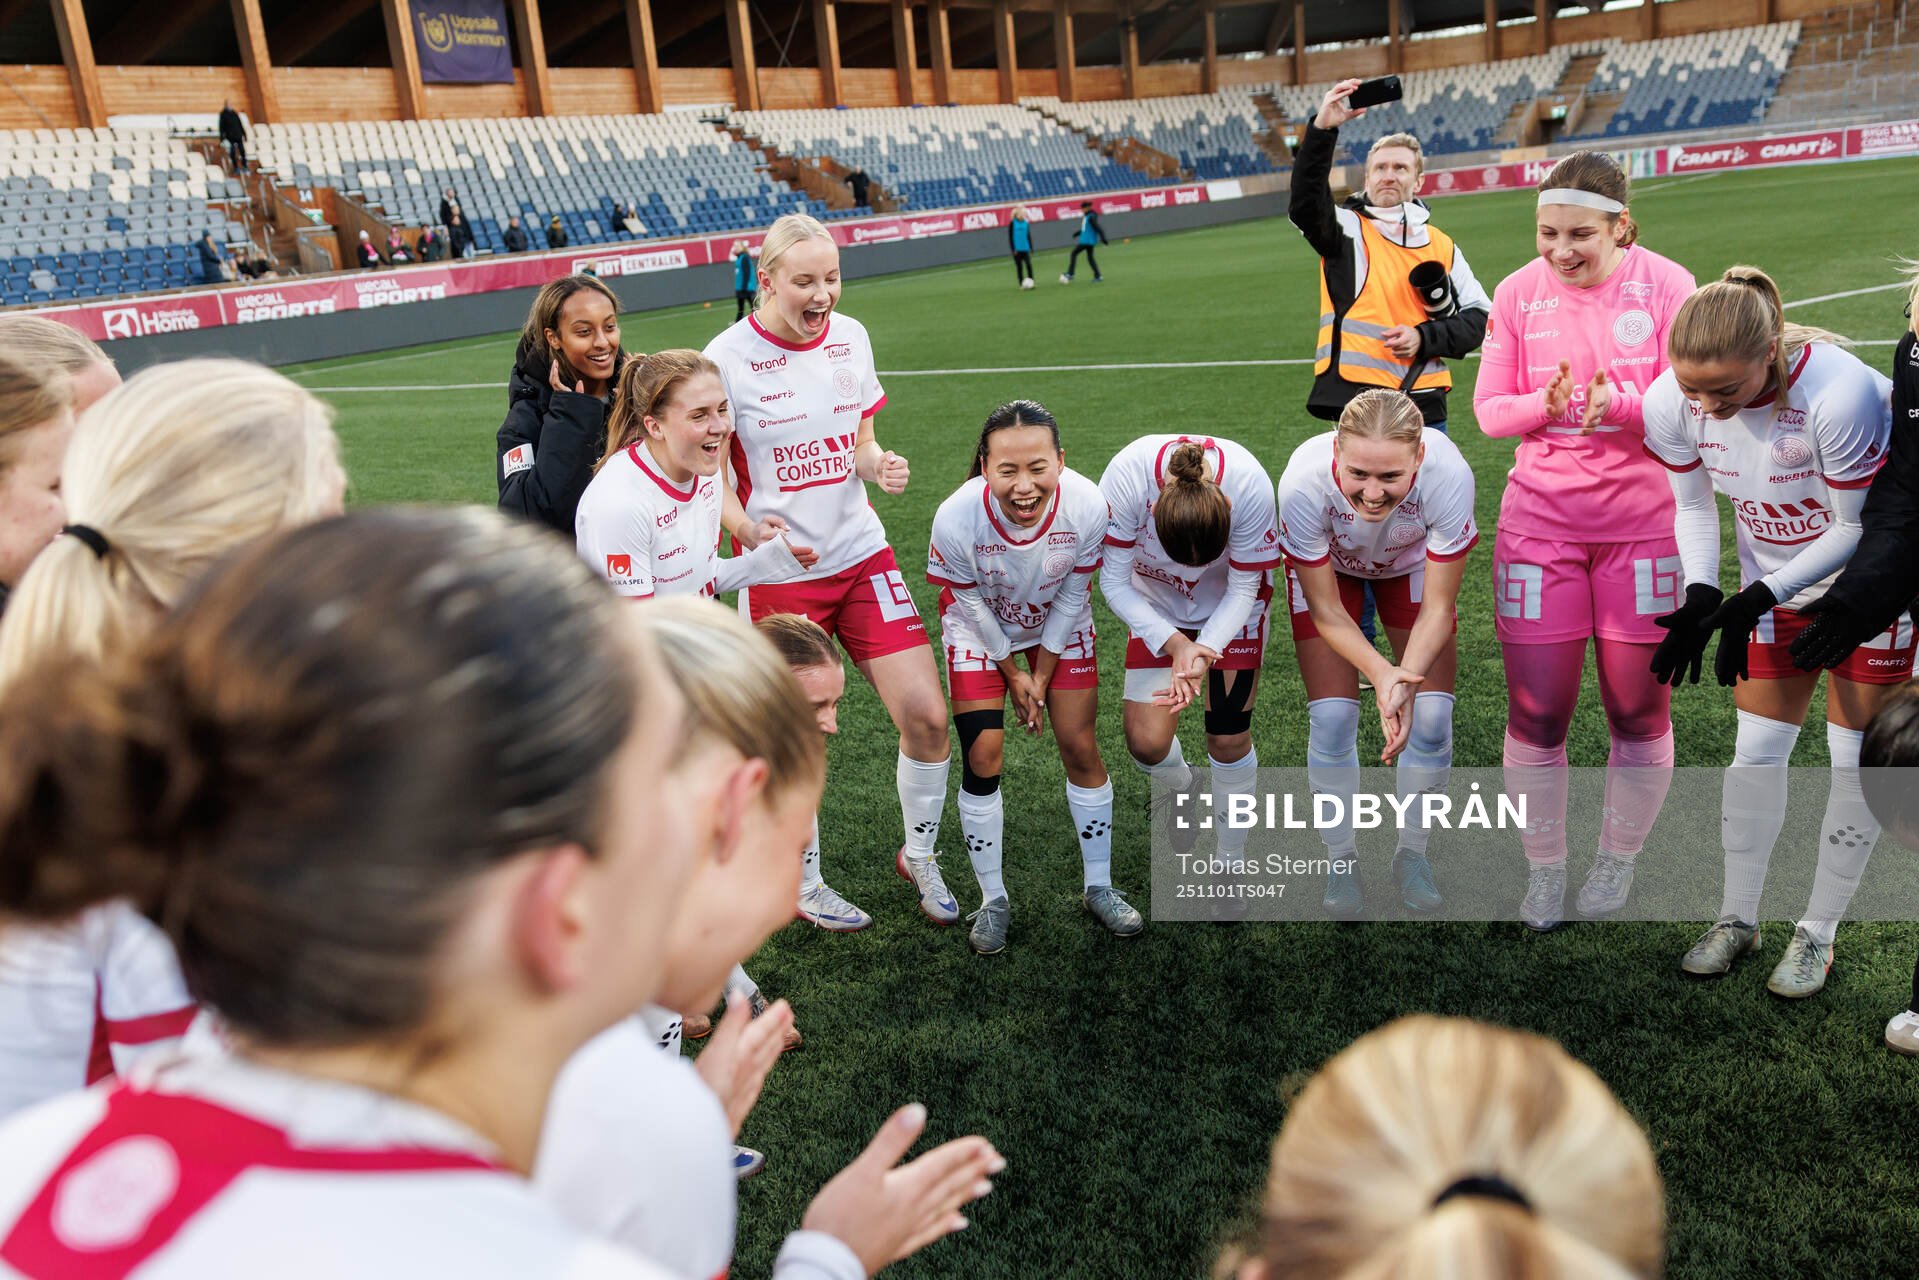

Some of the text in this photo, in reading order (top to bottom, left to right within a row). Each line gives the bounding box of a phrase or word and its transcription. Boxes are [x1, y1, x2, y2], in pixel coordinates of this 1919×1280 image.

[1677, 149, 1730, 167] CRAFT
[1760, 140, 1820, 159] CRAFT
[626, 254, 682, 271] CENTRALEN
[358, 283, 445, 309] SPORTS
[237, 297, 335, 324] SPORTS
[141, 310, 200, 335] Home
[1523, 330, 1552, 340] CRAFT
[760, 392, 788, 403] CRAFT
[773, 440, 820, 463] BYGG
[658, 547, 682, 561] CRAFT
[628, 578, 644, 586] SPEL
[1070, 666, 1092, 674] CRAFT
[1867, 658, 1901, 667] CRAFT
